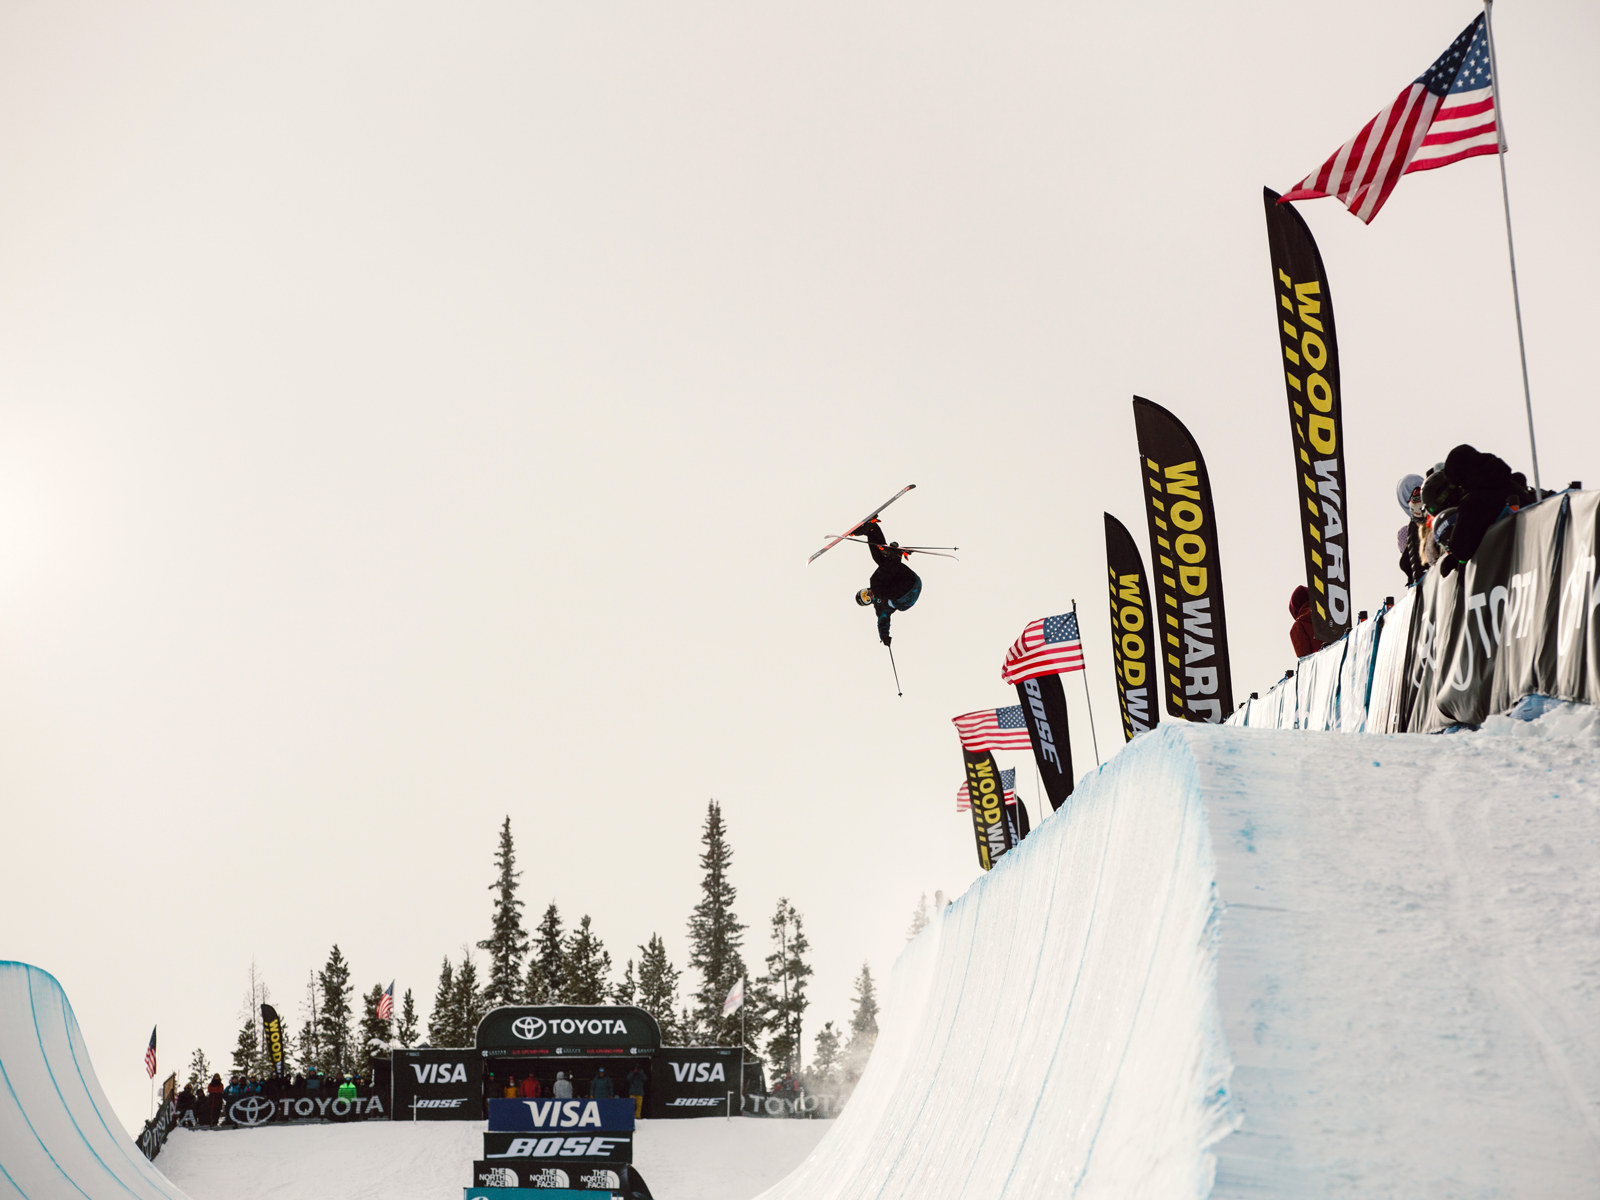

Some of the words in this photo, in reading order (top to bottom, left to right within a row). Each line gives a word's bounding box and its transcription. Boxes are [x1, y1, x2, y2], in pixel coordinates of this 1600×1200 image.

[1294, 280, 1350, 626] WOODWARD
[1023, 677, 1063, 774] BOSE
[549, 1019, 628, 1035] TOYOTA
[409, 1063, 468, 1084] VISA
[668, 1062, 726, 1083] VISA
[279, 1095, 385, 1116] TOYOTA
[407, 1098, 468, 1108] BOSE
[666, 1097, 726, 1107] BOSE
[522, 1101, 602, 1128] VISA
[486, 1136, 631, 1159] BOSE
[479, 1173, 505, 1181] NORTH
[587, 1181, 607, 1189] FACE
